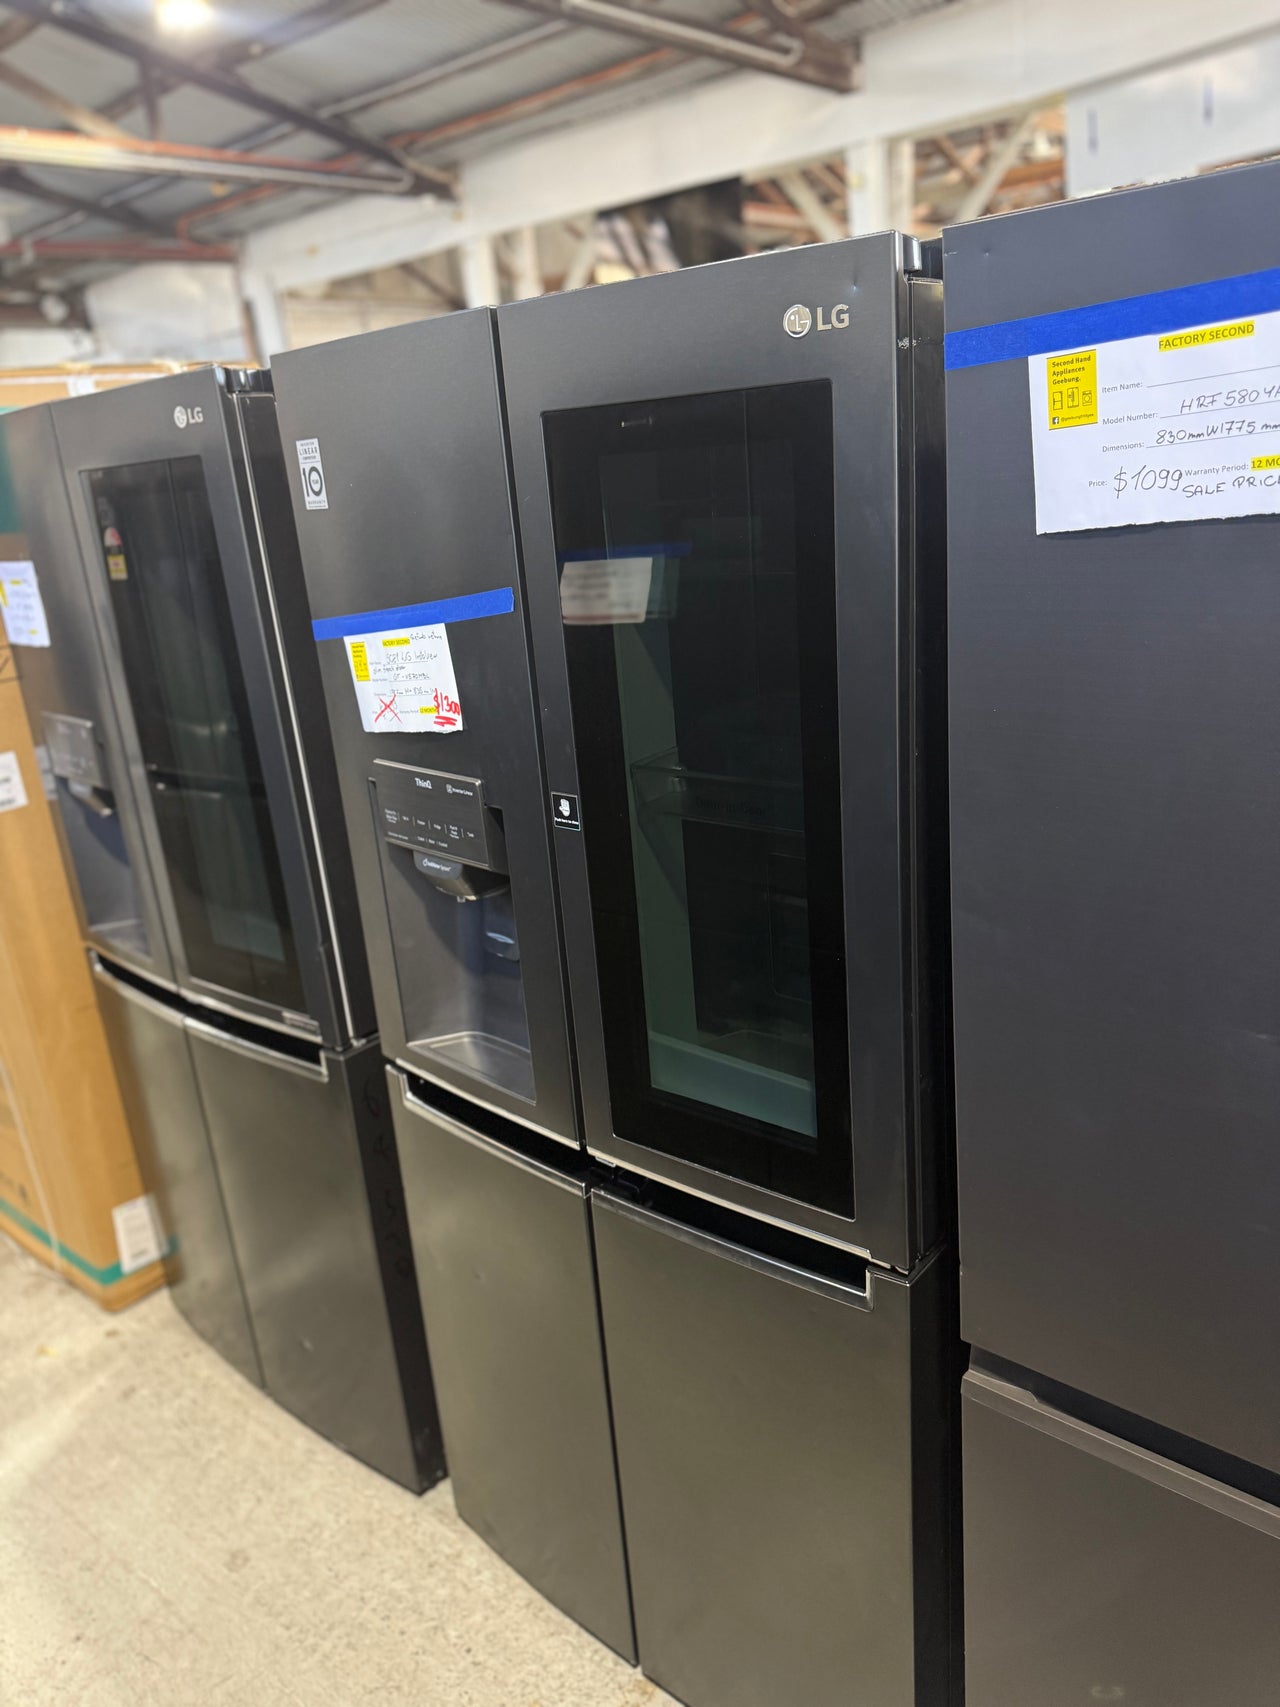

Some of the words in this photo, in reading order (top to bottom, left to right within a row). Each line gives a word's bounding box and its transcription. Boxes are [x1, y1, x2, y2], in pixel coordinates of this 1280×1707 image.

[816, 304, 850, 330] LG
[1159, 332, 1206, 350] FACTORY
[1209, 324, 1254, 341] SECOND
[1052, 357, 1074, 368] Second
[1076, 354, 1091, 363] Hand
[1052, 366, 1085, 377] Appliances
[1053, 376, 1080, 385] Geebung.
[1102, 385, 1118, 393] Item
[1119, 381, 1143, 390] Name:
[1180, 392, 1223, 414] HRF
[1224, 389, 1260, 407] 580
[187, 406, 204, 424] LG
[1102, 415, 1125, 425] Model
[1126, 412, 1158, 422] Number:
[299, 446, 318, 456] LINEAR
[1102, 441, 1144, 452] Dimensions:
[1185, 465, 1220, 477] Warranty
[1221, 463, 1249, 473] Period:
[1251, 459, 1262, 469] 12
[302, 466, 323, 497] 10
[1088, 480, 1108, 488] Price:
[1114, 464, 1182, 499] $1099
[1182, 482, 1226, 498] SALE
[415, 777, 432, 789] ThinQ
